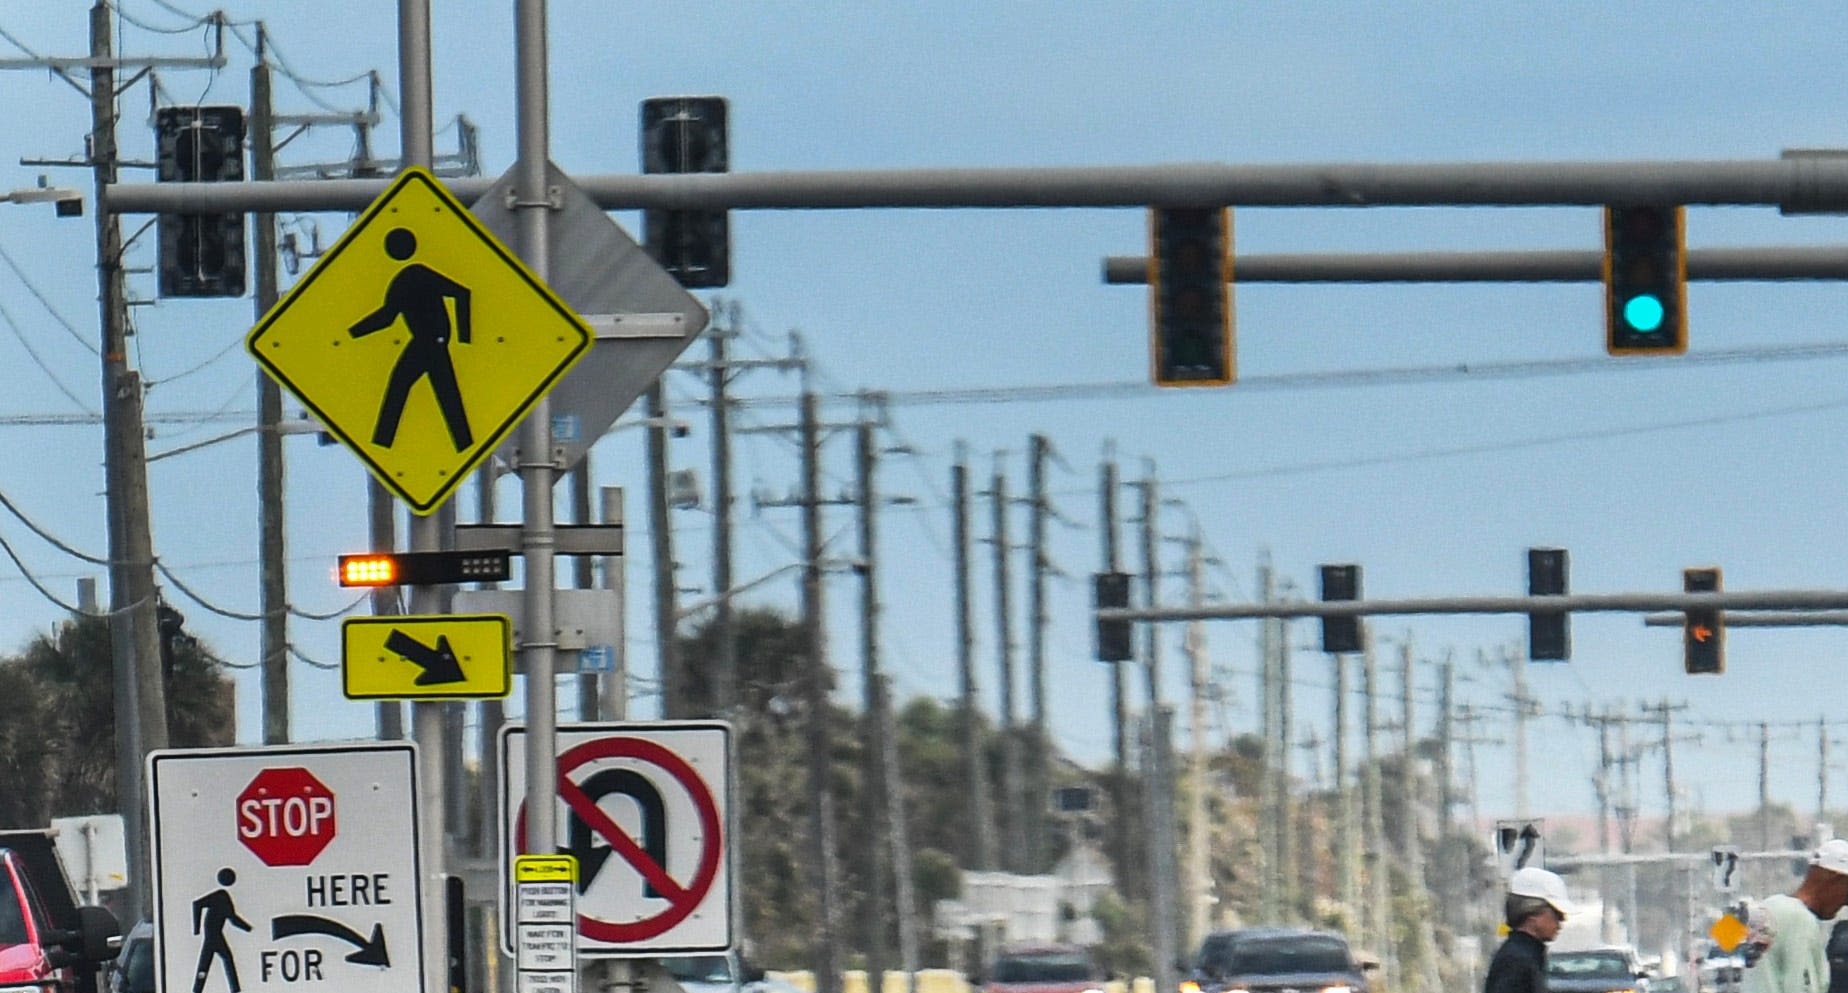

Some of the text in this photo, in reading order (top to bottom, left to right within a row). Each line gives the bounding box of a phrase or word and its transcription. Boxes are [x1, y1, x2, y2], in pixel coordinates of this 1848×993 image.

[240, 797, 332, 838] STOP
[306, 873, 391, 907] HERE
[260, 949, 323, 983] FOR
